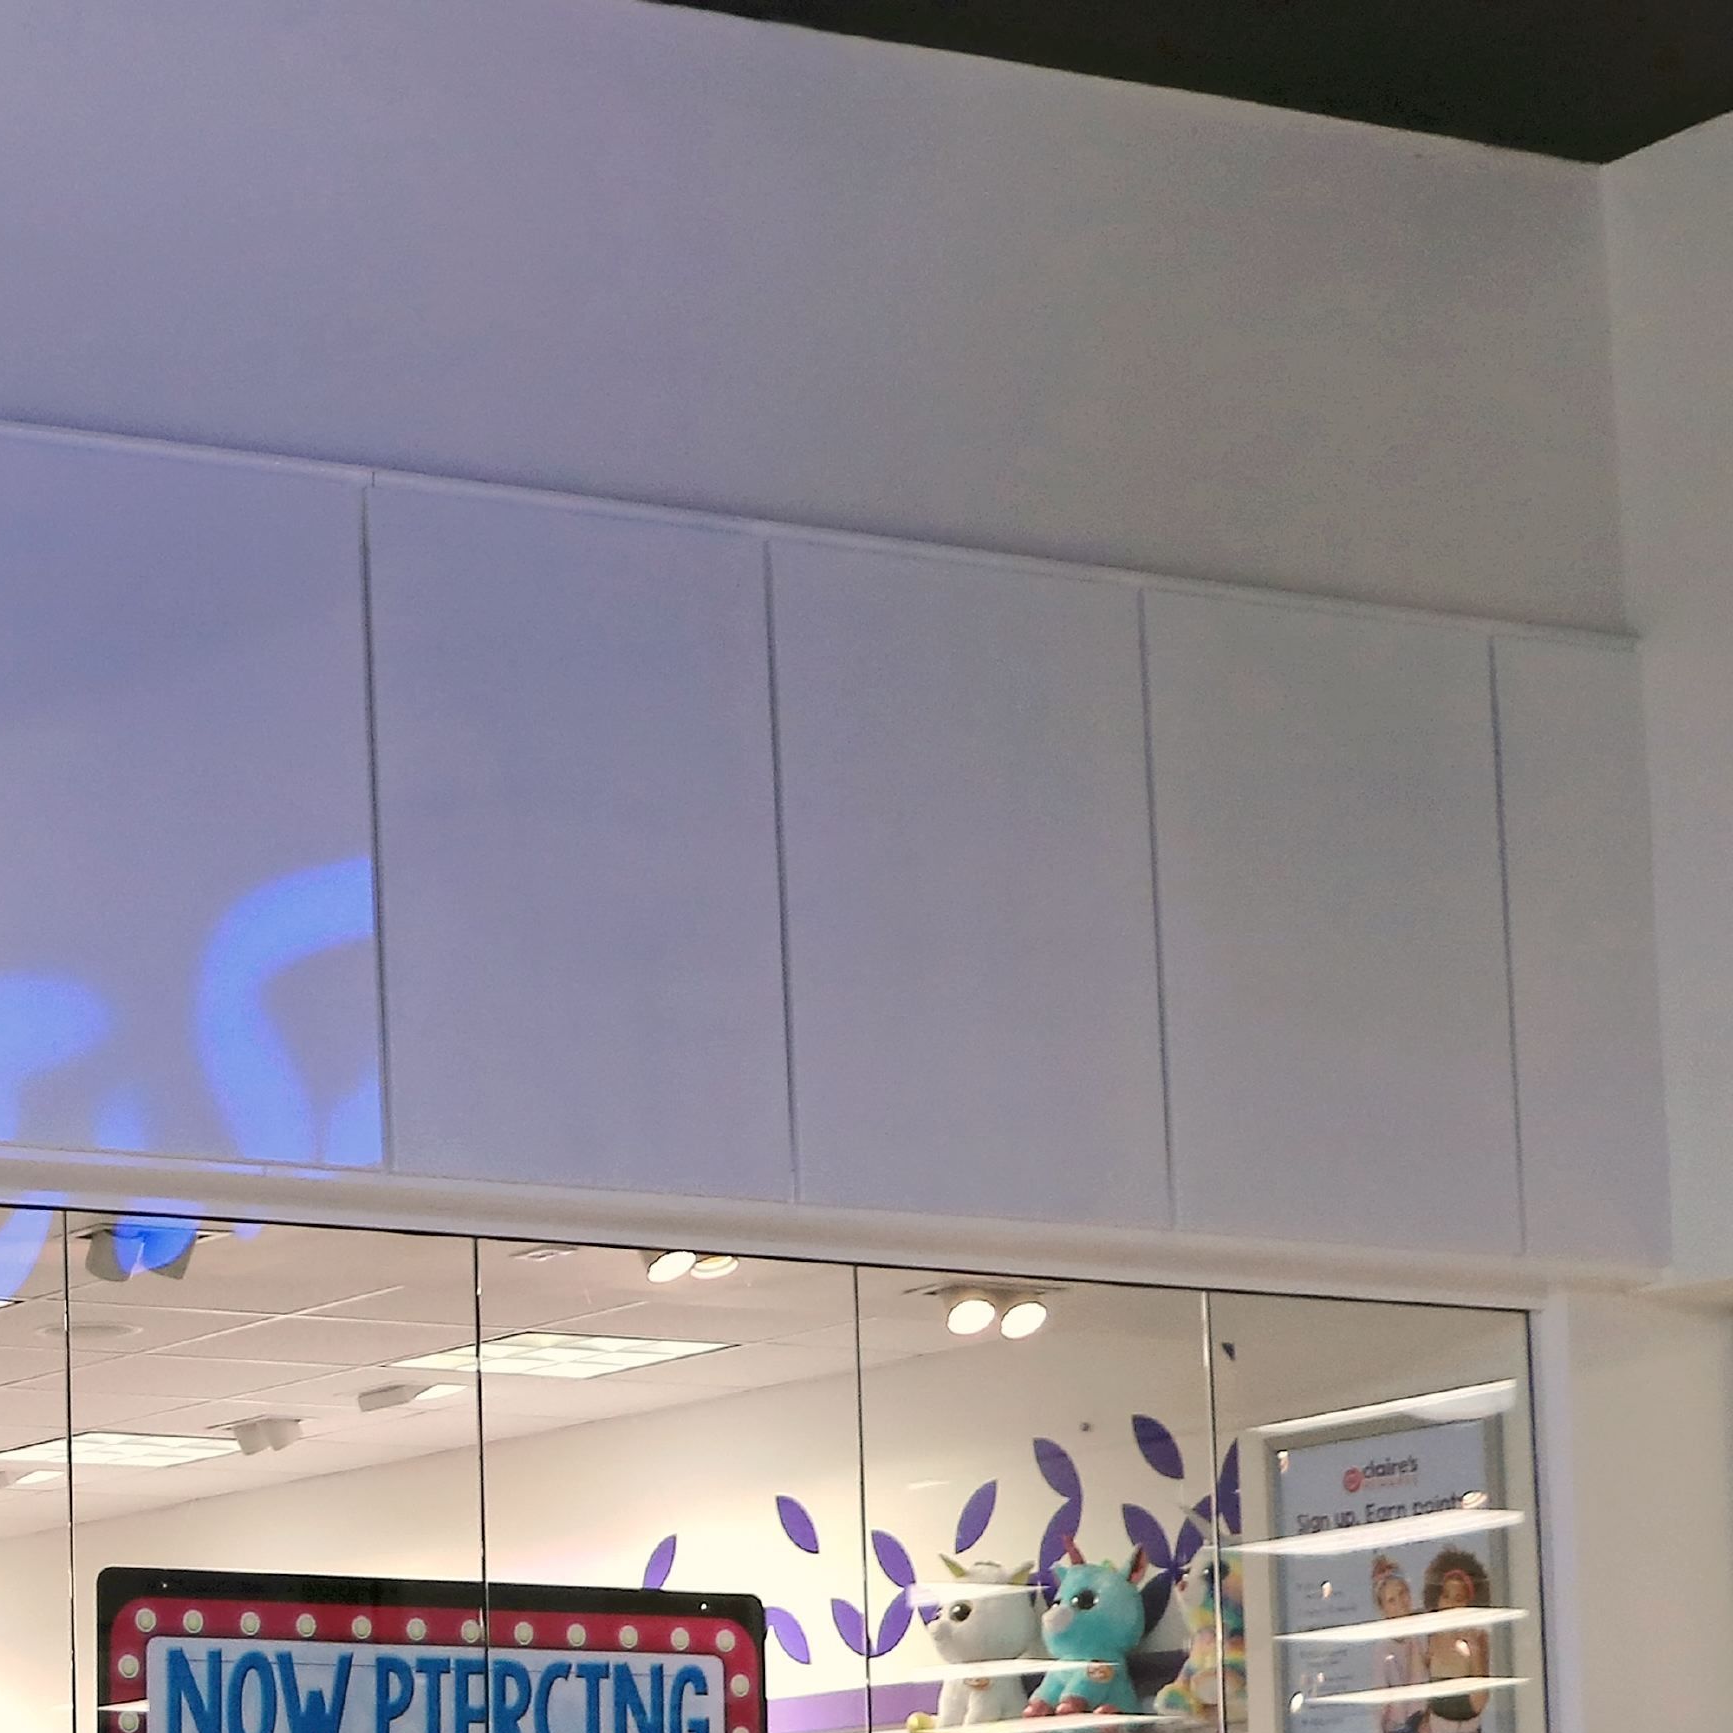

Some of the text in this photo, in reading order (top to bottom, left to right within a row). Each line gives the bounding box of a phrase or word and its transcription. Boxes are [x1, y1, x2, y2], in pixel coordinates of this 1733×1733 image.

[1362, 1455, 1419, 1479] claire's
[1365, 1503, 1408, 1523] Earn
[1413, 1491, 1462, 1516] point
